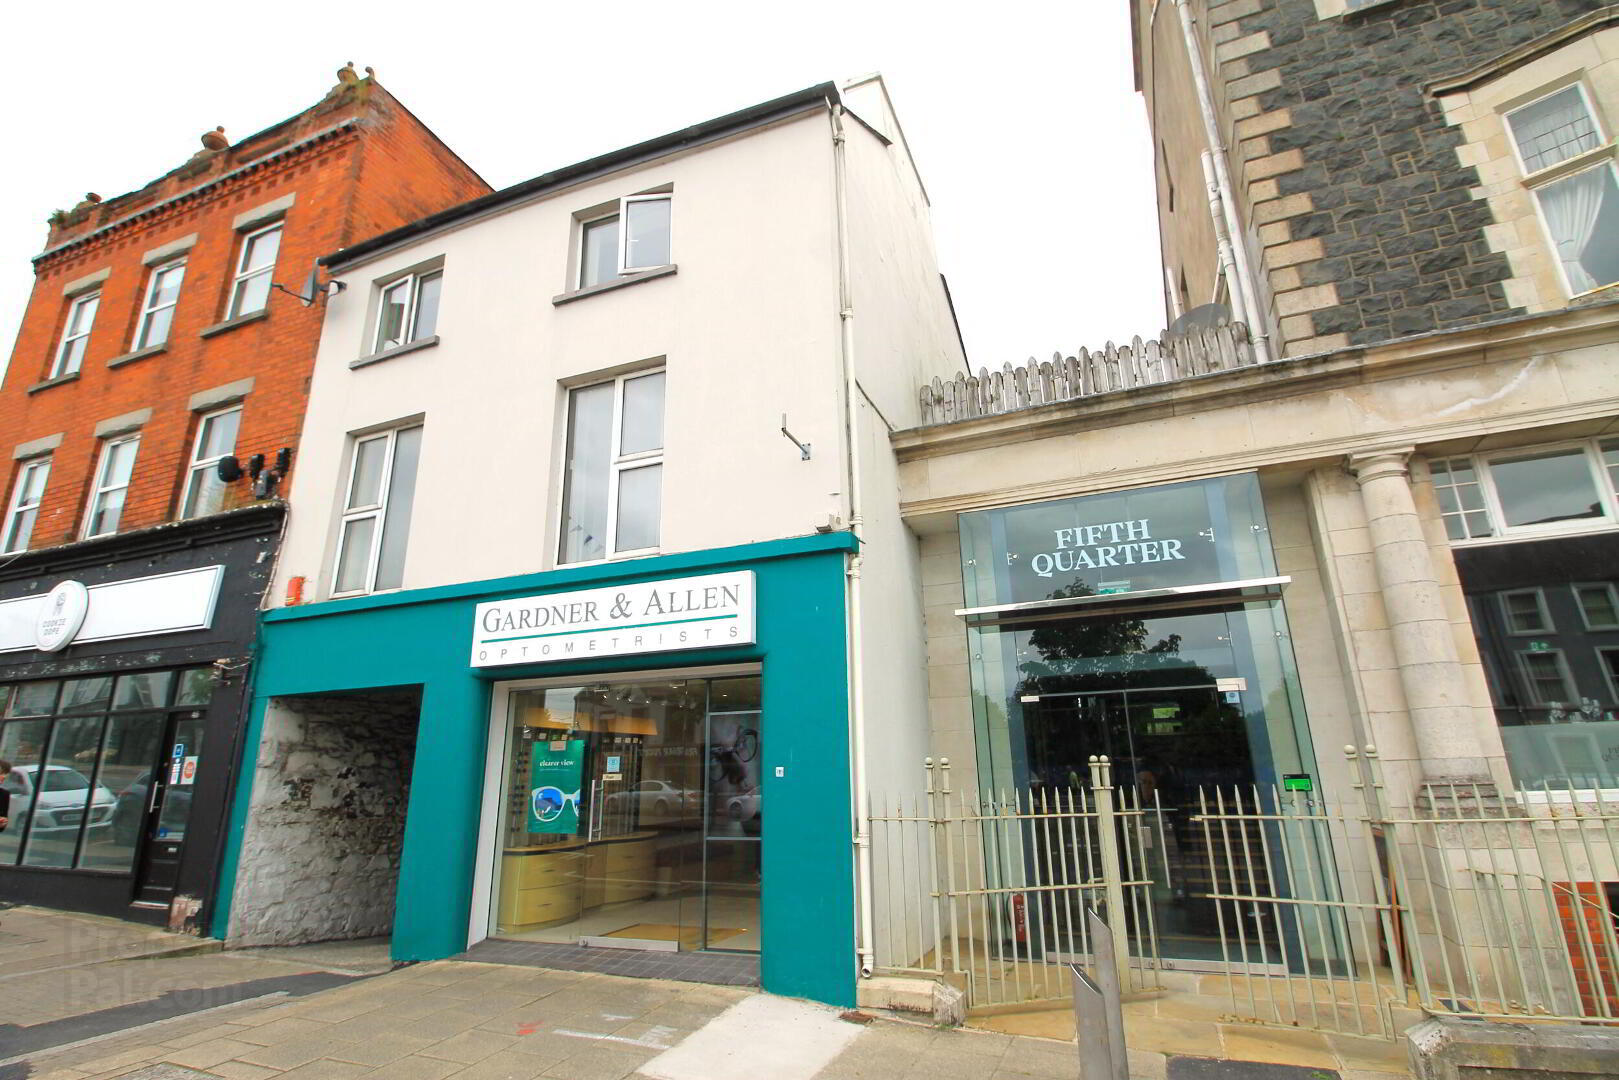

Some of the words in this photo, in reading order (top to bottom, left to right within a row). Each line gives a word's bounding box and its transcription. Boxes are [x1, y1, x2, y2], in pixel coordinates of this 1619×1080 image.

[1054, 518, 1151, 550] FIFTH
[1031, 539, 1186, 578] QUARTER
[482, 601, 599, 632] GARDNER
[609, 592, 633, 620] &
[643, 584, 740, 616] ALLEN
[480, 626, 738, 660] OPTOMETRISTS
